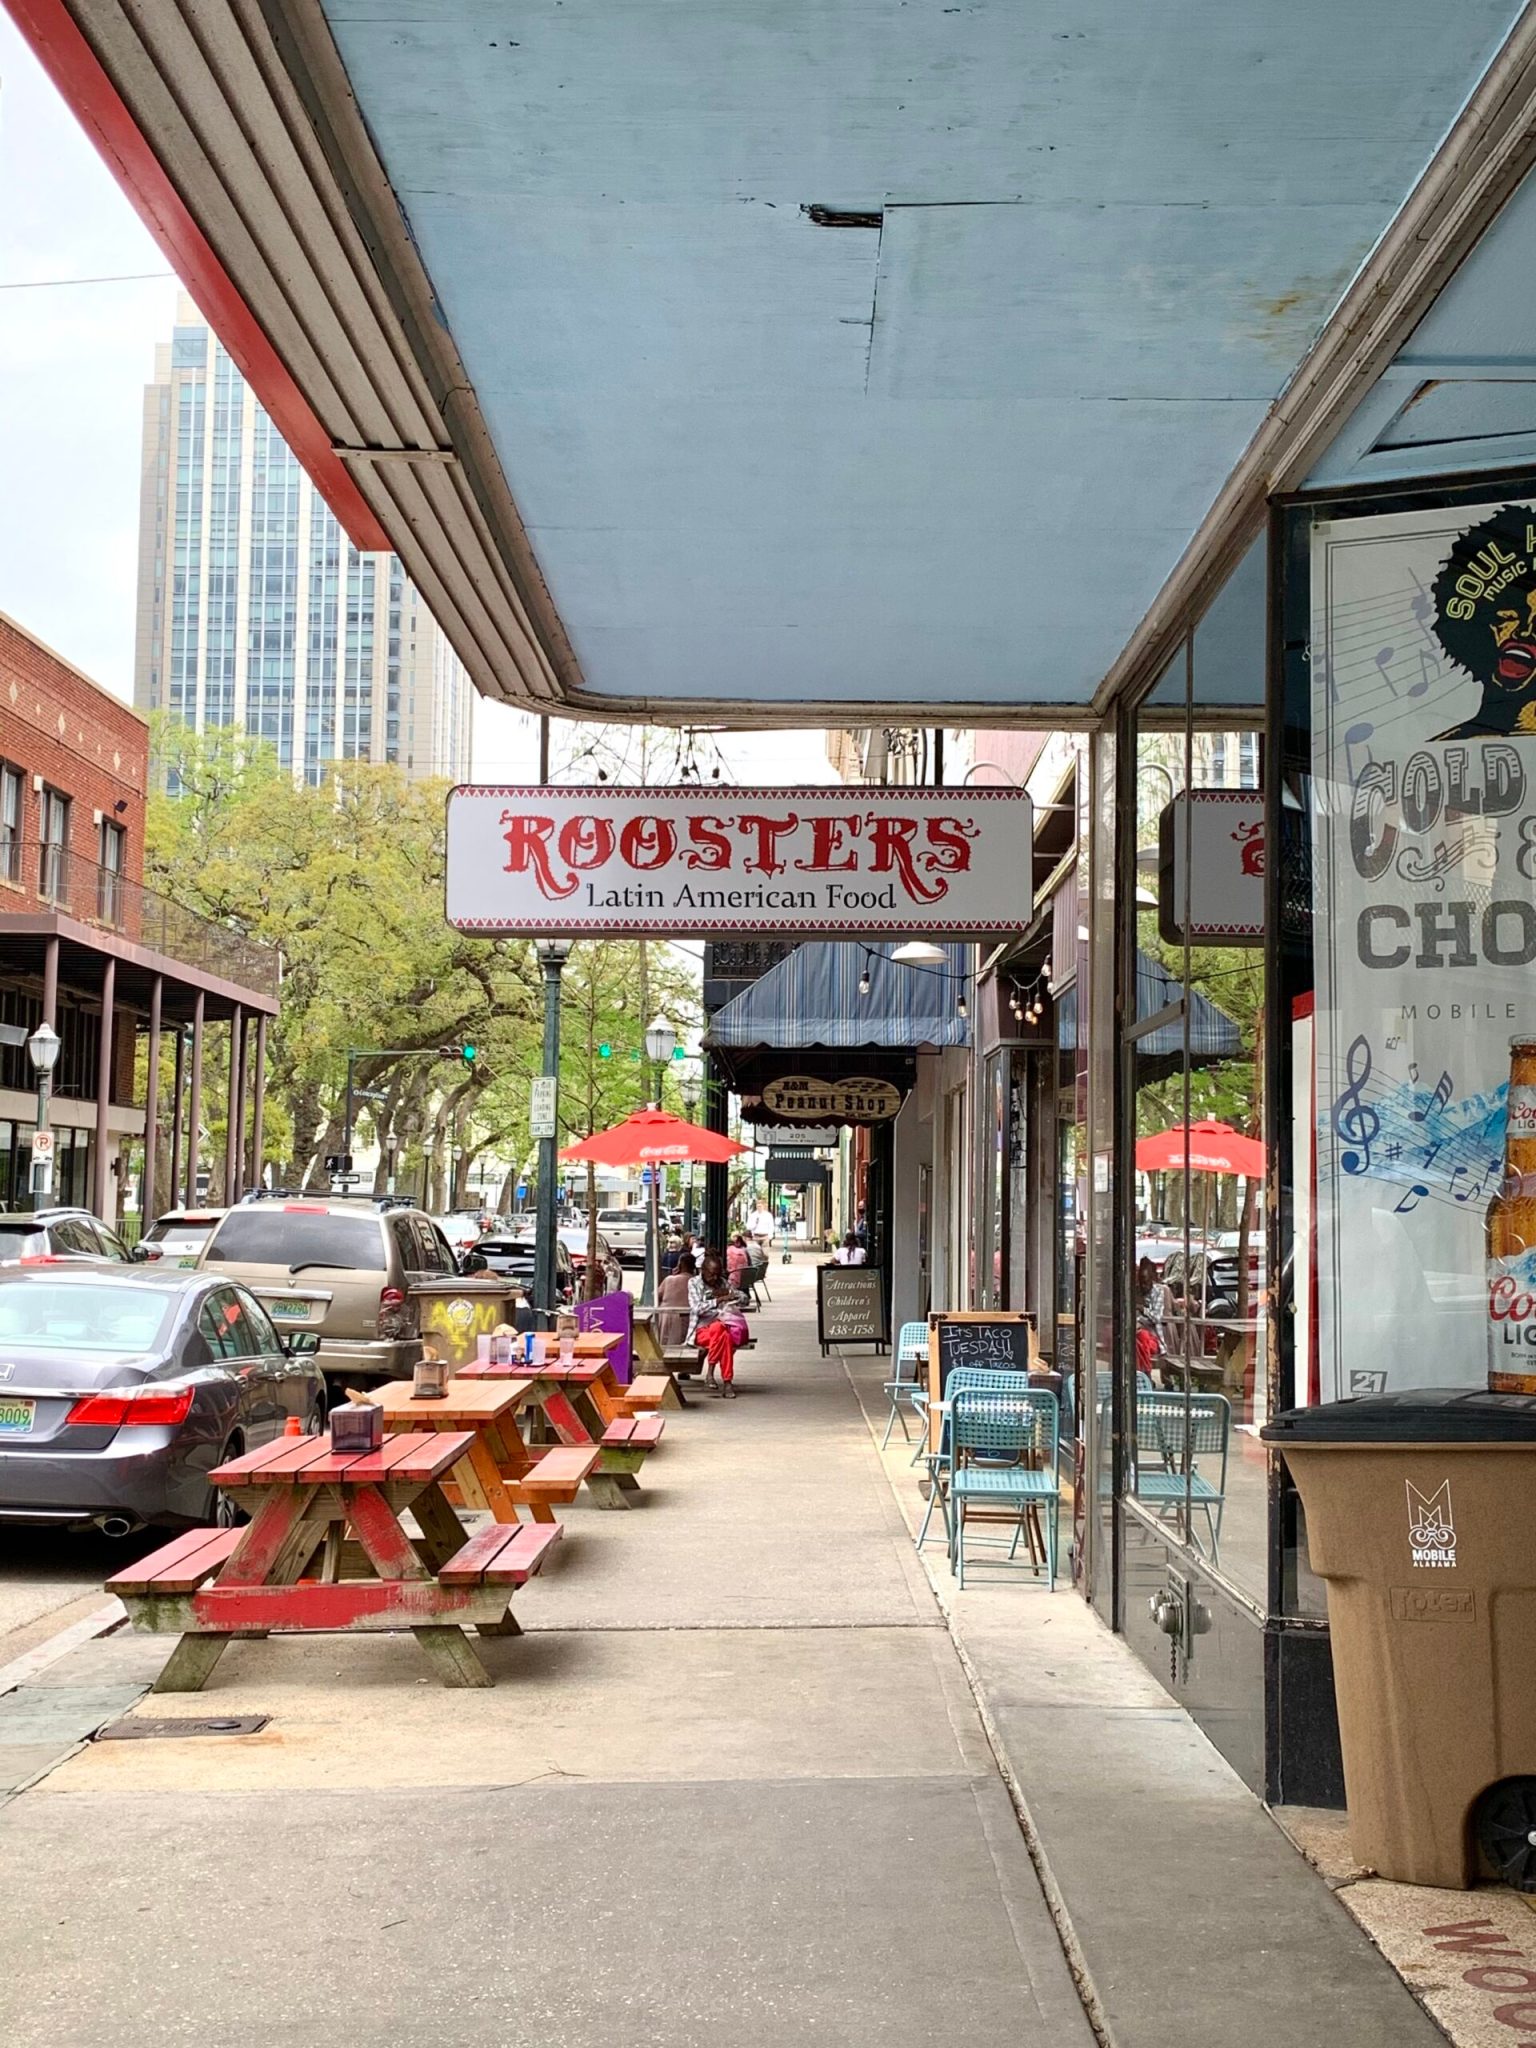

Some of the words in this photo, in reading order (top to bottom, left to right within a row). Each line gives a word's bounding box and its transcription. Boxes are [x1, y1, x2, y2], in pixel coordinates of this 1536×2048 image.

[1446, 541, 1516, 620] SOUL
[1351, 744, 1526, 883] COLD
[498, 809, 981, 904] ROOSTERS
[586, 883, 665, 908] Latin
[673, 883, 816, 909] American
[826, 884, 897, 909] Food
[1357, 900, 1536, 969] CHO
[1401, 1003, 1516, 1020] MOBILE
[775, 1093, 836, 1110] Peanut
[844, 1094, 887, 1114] Shop
[832, 1310, 871, 1323] Apparel
[828, 1324, 875, 1336] 438-1758
[1352, 1371, 1383, 1393] 21
[1412, 1549, 1456, 1561] MOBILE
